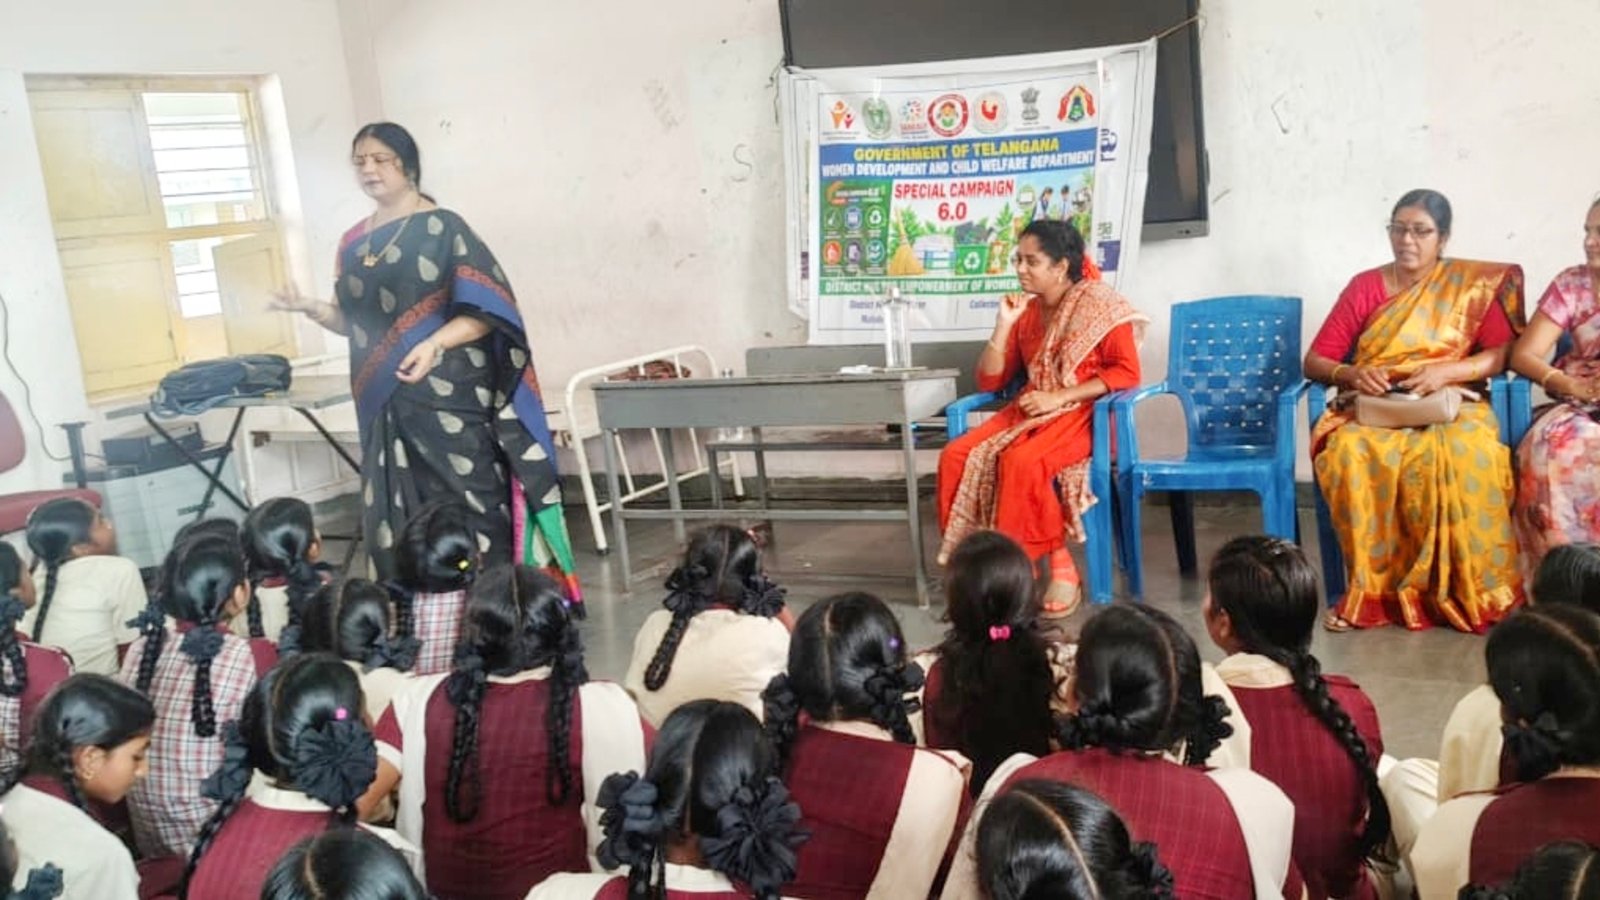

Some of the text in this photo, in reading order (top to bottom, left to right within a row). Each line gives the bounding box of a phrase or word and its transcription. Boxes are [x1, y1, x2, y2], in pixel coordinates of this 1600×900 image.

[853, 137, 1060, 162] GOVERNMENT OF TELANGANA
[821, 150, 1095, 177] WOMEN DEVELOPMENT AND CHILD WELFARE DEPARTMENT
[894, 183, 945, 199] SPECIAL
[950, 180, 1015, 198] CAMPAIGN
[938, 202, 967, 220] 6.0
[825, 280, 862, 294] DISTRICT
[970, 279, 983, 292] OF
[984, 278, 1019, 292] WOMEN
